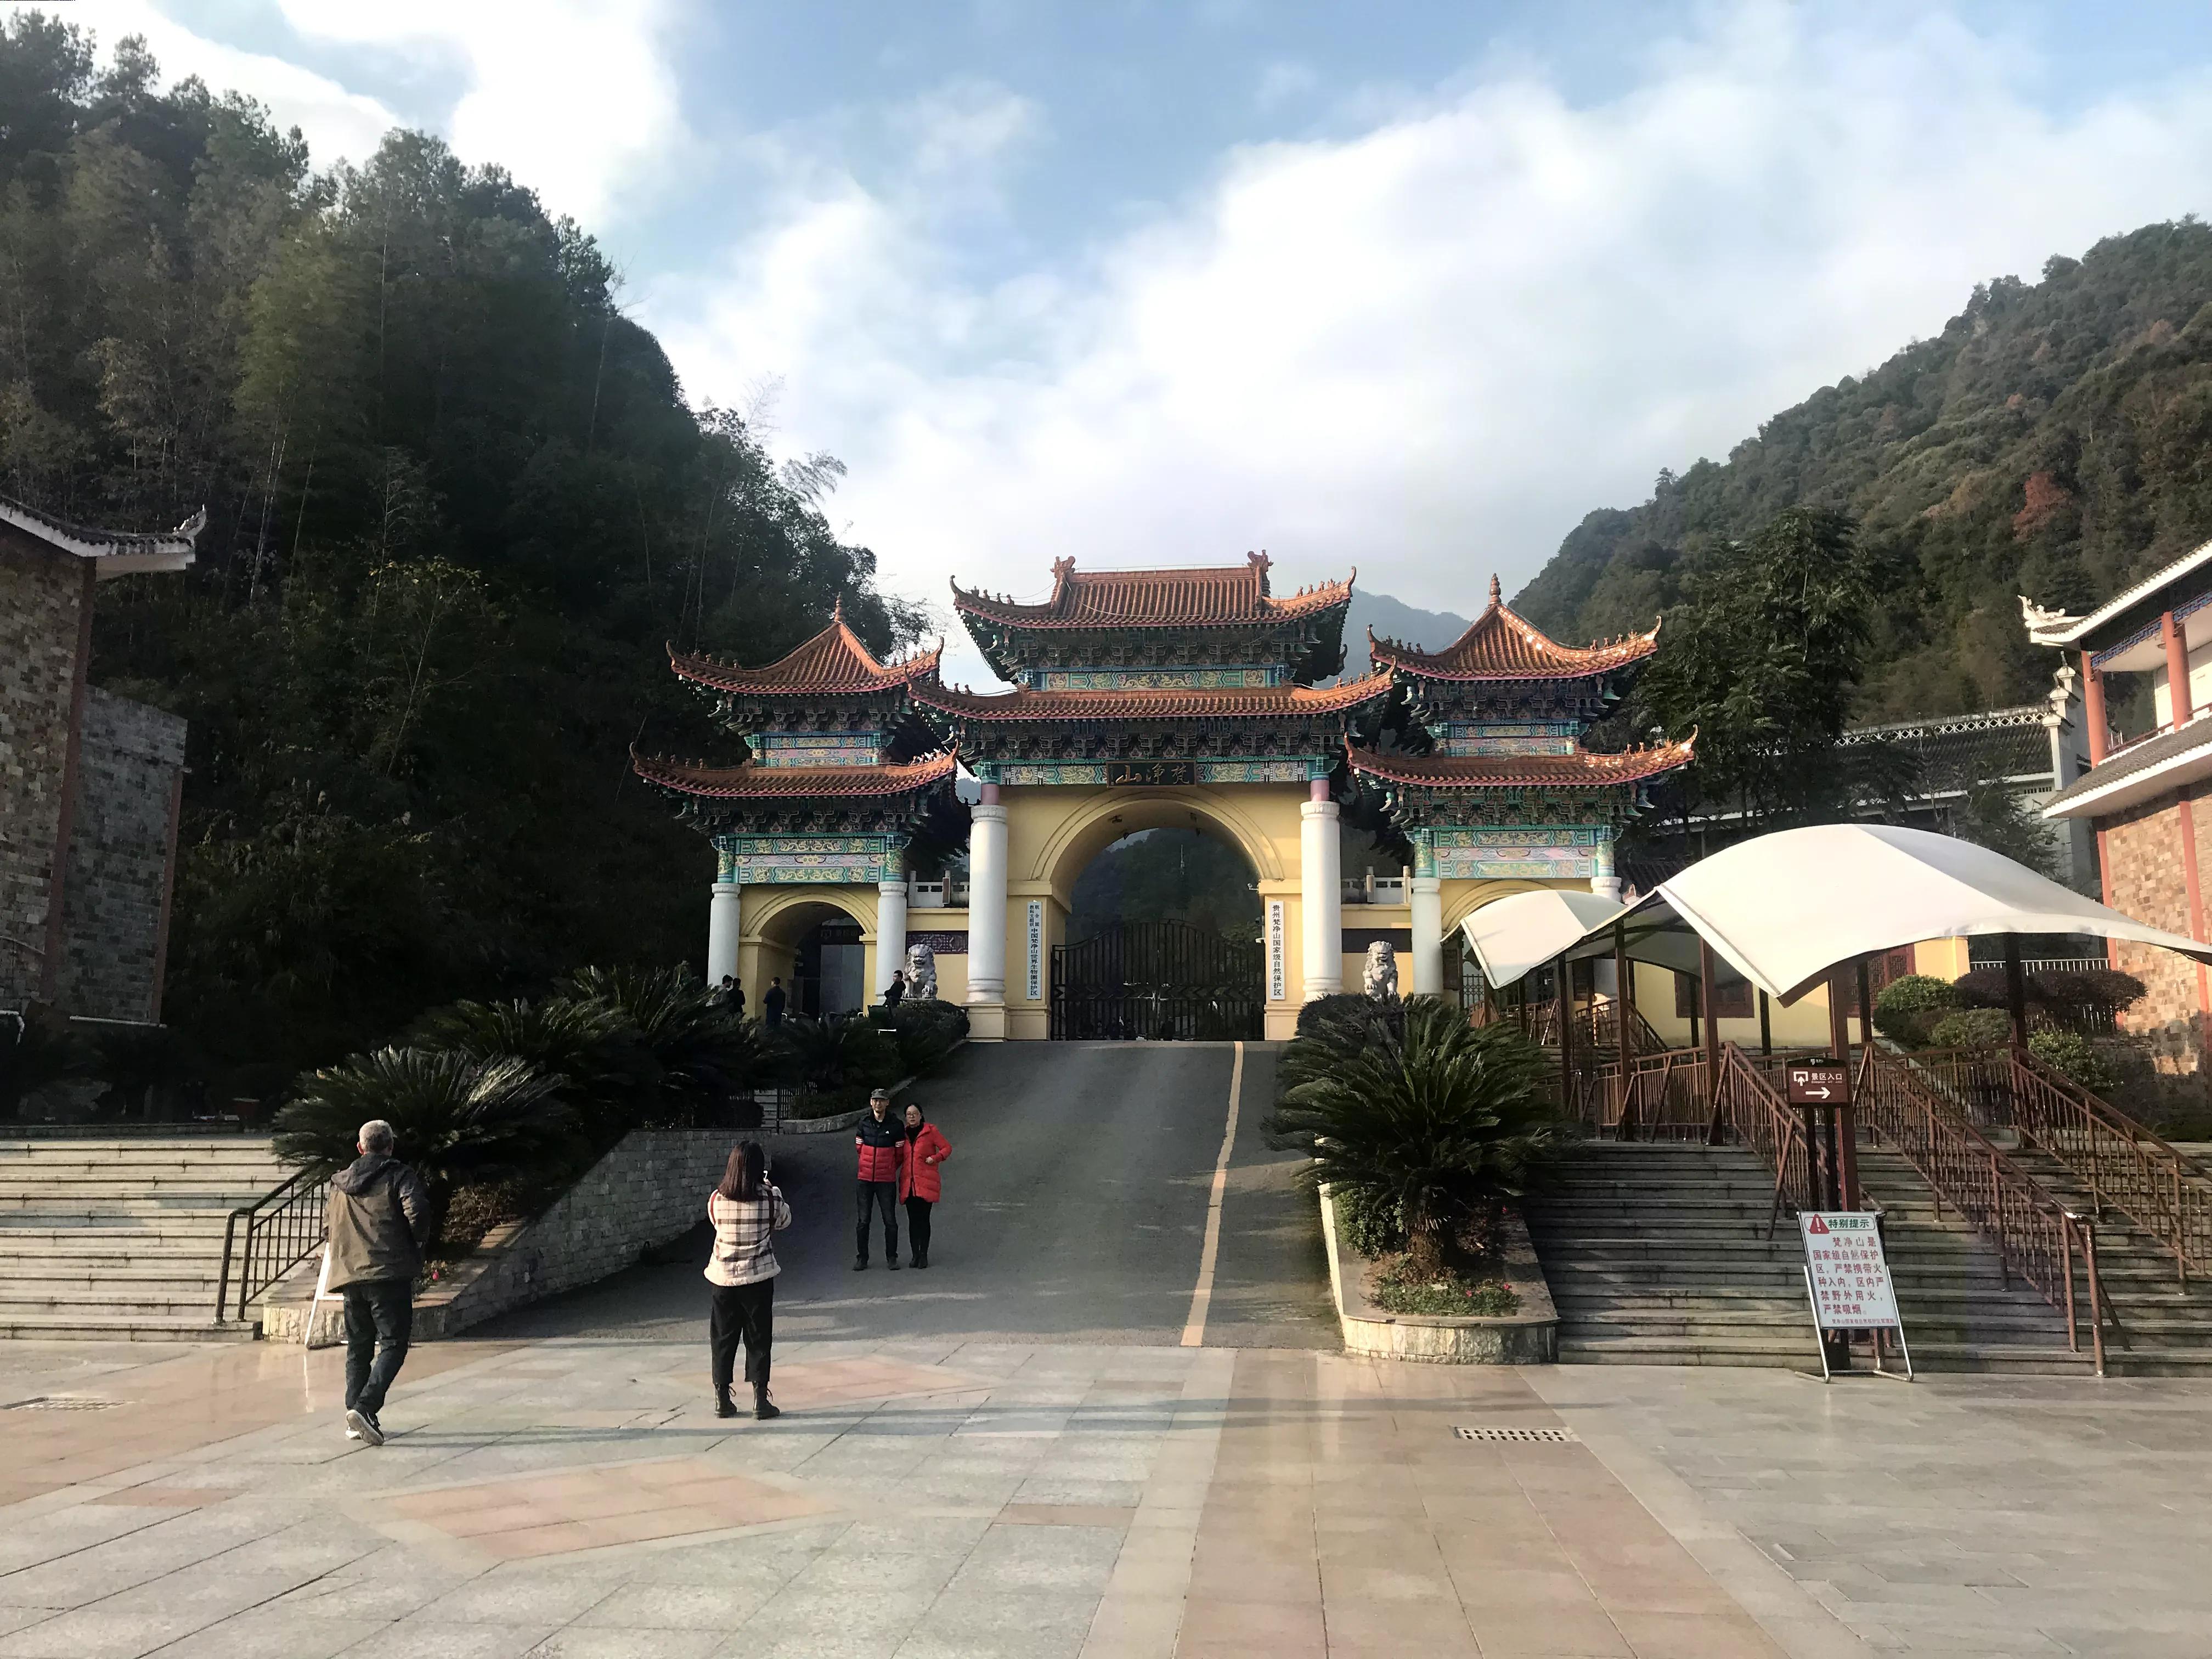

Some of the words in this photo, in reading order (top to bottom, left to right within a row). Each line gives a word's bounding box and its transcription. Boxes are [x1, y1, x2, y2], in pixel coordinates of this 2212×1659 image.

[1272, 905, 1282, 996] 贵州梵净山国家级自然保护区
[1828, 1218, 1869, 1228] 特别提示
[1832, 1237, 1876, 1247] 梵净山是
[1813, 1250, 1878, 1261] 国家级自然保护
